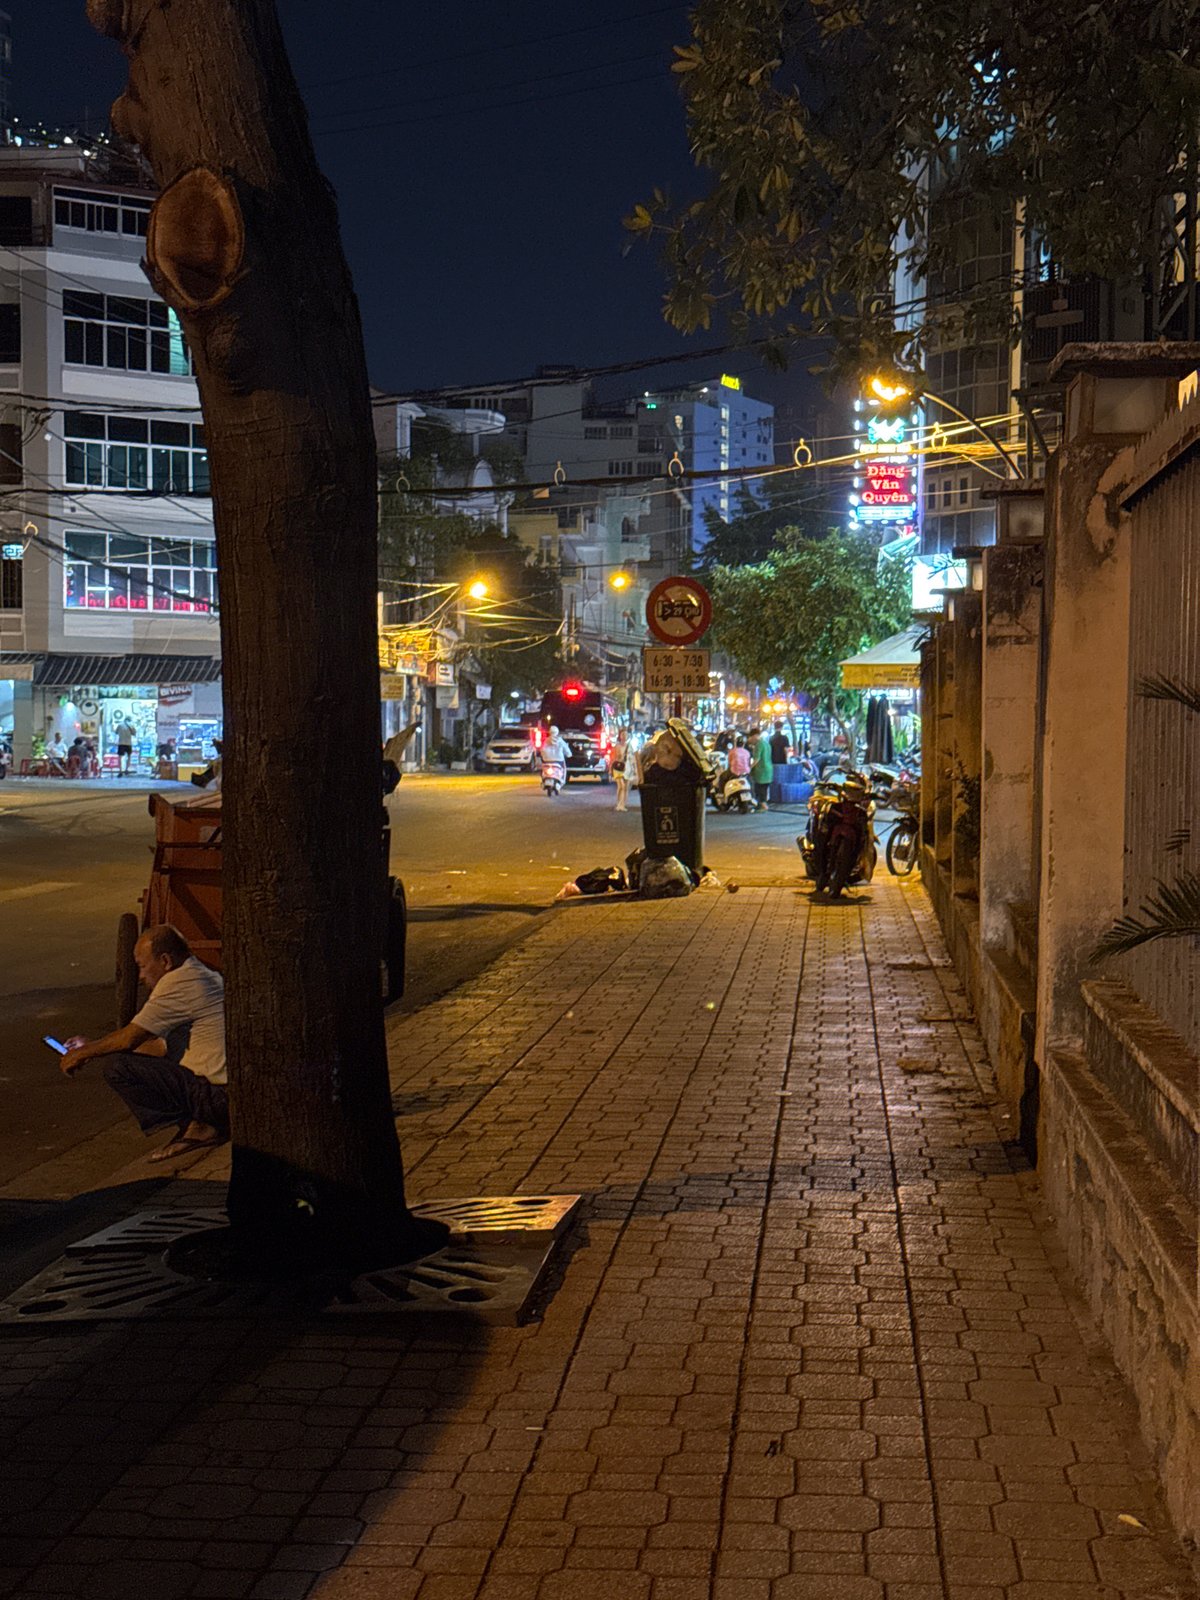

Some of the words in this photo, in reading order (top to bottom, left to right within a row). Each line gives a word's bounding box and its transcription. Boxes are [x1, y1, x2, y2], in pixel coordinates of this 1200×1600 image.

[867, 465, 905, 478] Đặng
[871, 479, 900, 490] Văn
[862, 491, 909, 504] Quyên
[653, 655, 673, 667] 6:30
[683, 655, 703, 667] 7:30
[651, 675, 673, 687] 16:30
[160, 686, 191, 696] BIVINA
